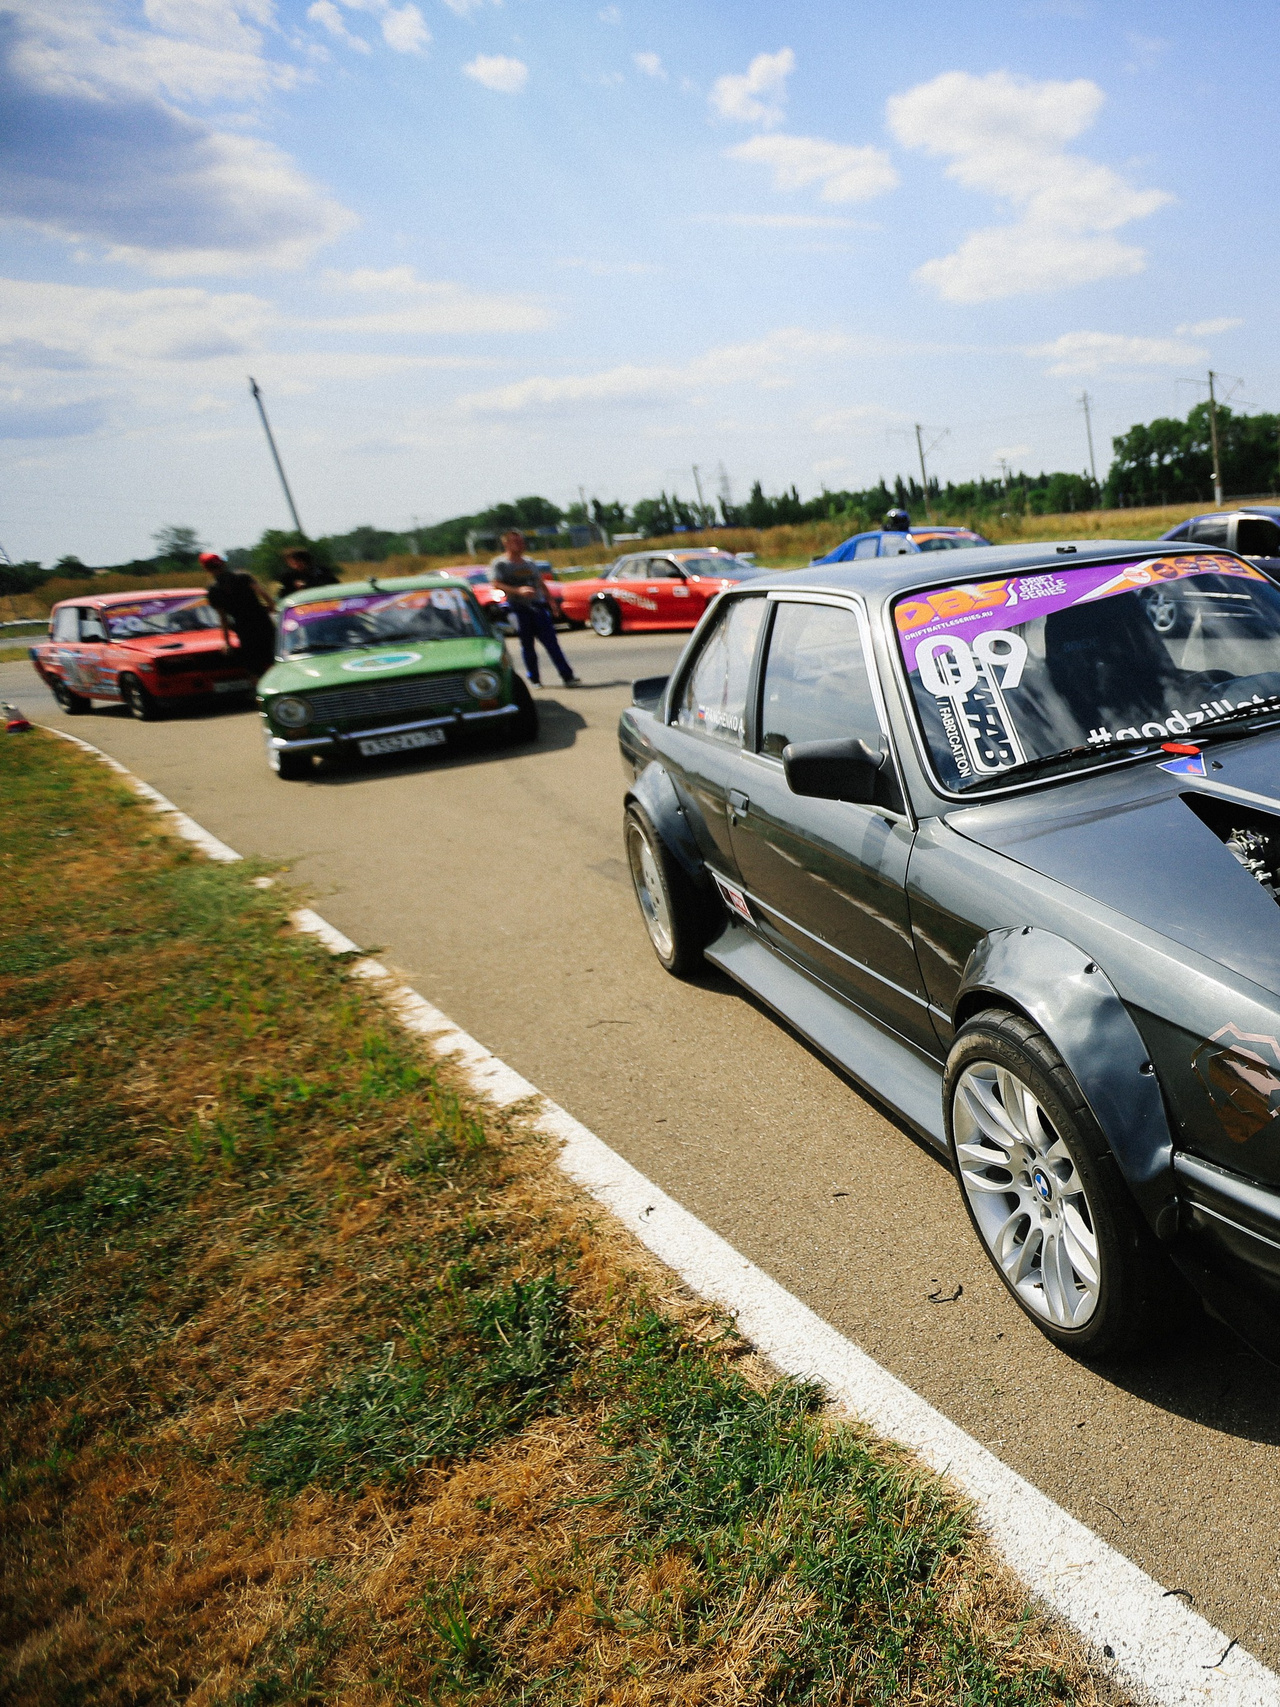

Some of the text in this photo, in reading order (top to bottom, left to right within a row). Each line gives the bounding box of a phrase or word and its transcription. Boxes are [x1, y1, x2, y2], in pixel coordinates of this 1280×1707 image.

[1019, 578, 1067, 593] BATTLE
[1020, 574, 1054, 586] DRIFT
[1020, 586, 1067, 600] SERIES
[894, 579, 1009, 631] DBS
[904, 610, 994, 641] DRIFTBATTLESERIES.RU
[915, 630, 1029, 697] 09
[939, 706, 972, 778] FABRICATION
